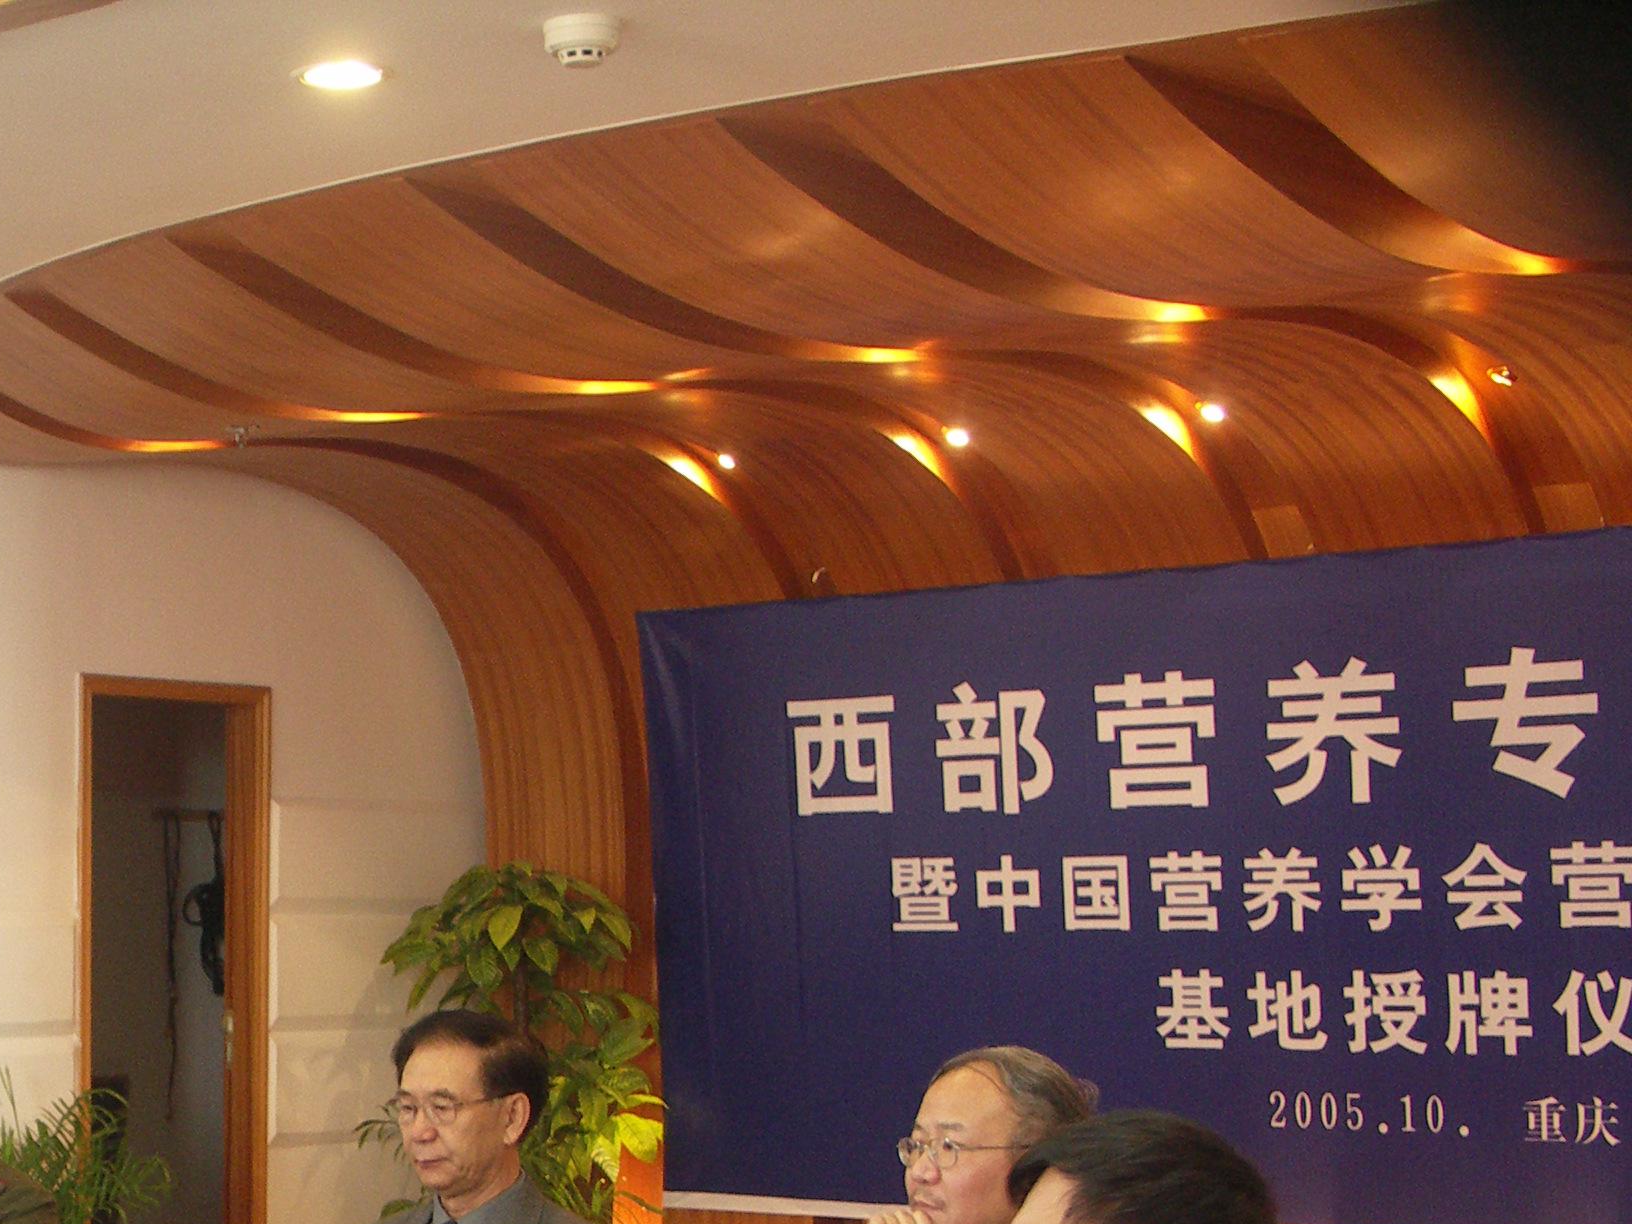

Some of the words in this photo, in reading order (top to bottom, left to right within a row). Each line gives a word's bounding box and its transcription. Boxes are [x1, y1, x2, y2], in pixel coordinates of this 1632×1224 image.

[786, 646, 1599, 817] 西部营养专
[891, 839, 1632, 933] 暨中国营养学会营
[1156, 968, 1632, 1057] 基地授牌仪
[1269, 1090, 1470, 1137] 2005.10.
[1524, 1096, 1621, 1146] 重庆
